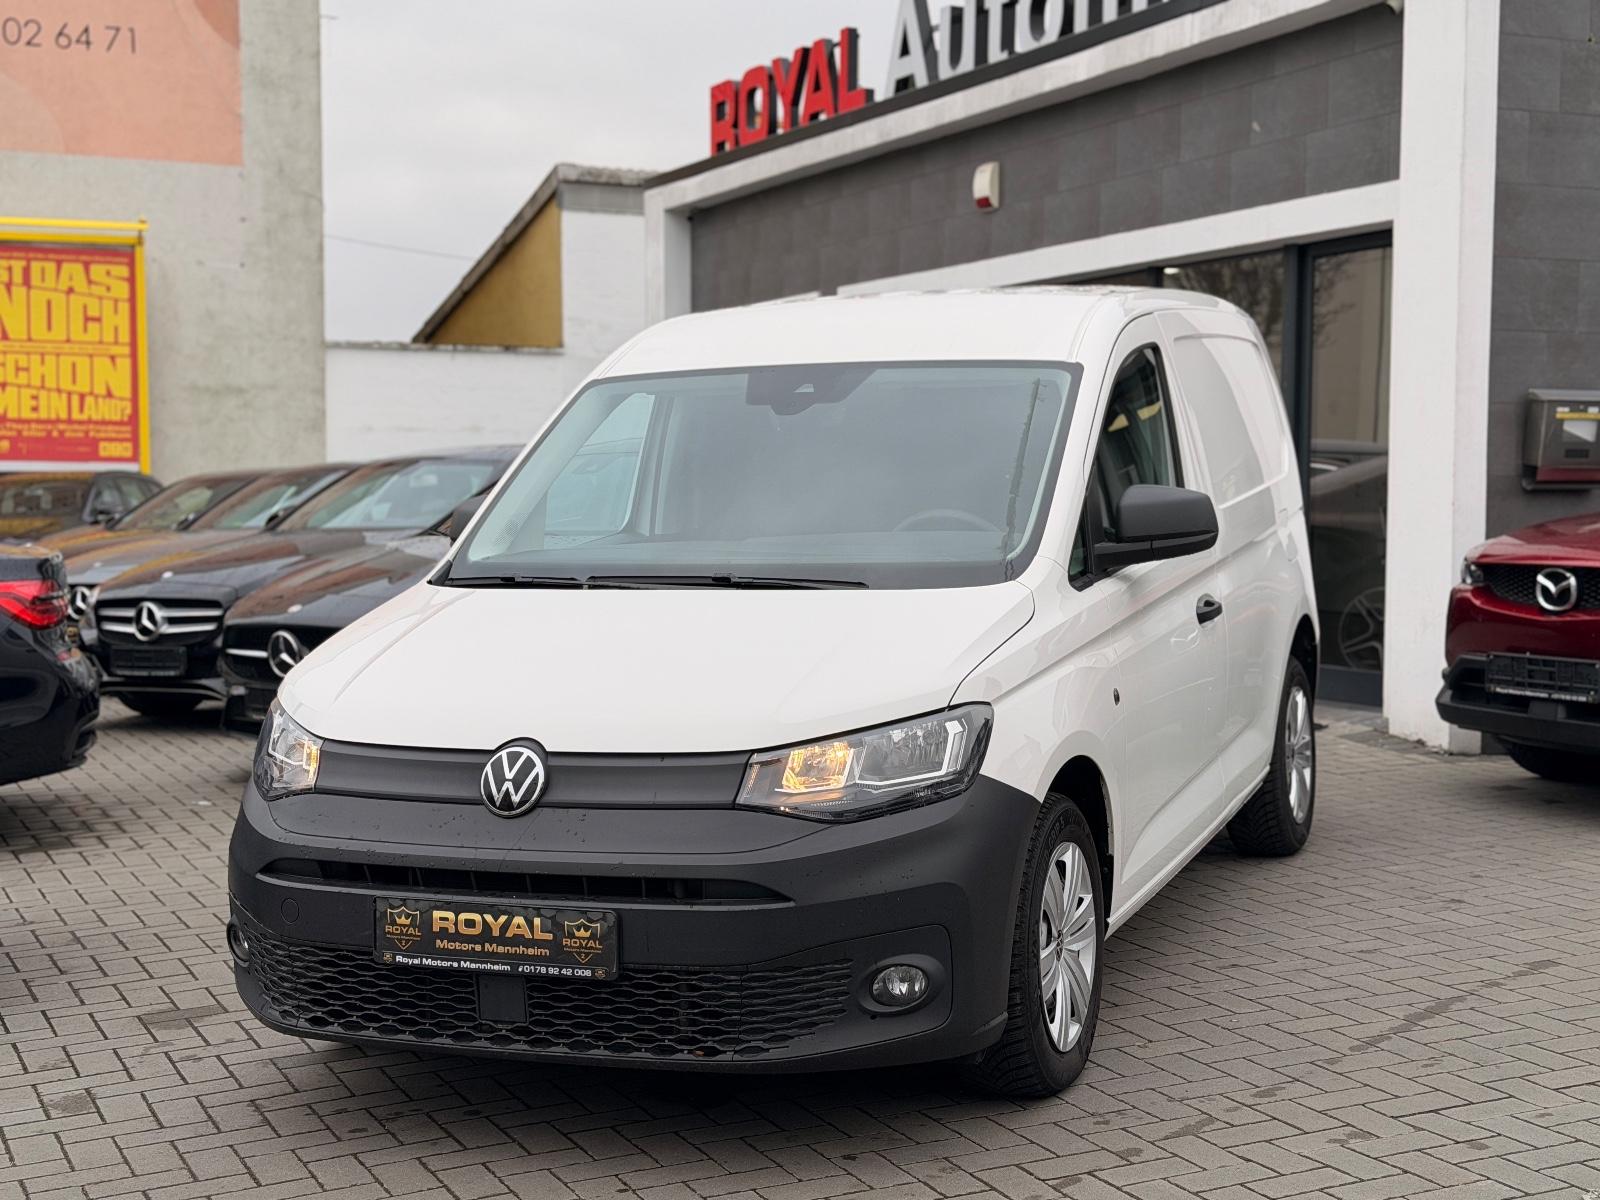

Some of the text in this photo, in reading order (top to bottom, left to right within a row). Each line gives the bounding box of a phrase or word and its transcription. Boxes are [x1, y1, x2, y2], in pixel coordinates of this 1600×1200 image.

[2, 17, 137, 55] 02 64 71
[710, 0, 1170, 157] ROYAL Auto
[30, 260, 130, 300] DAS
[0, 284, 130, 344] NOCH
[0, 351, 131, 399] CHON
[385, 925, 421, 936] ROYAL
[432, 910, 553, 940] ROYAL
[435, 939, 482, 951] Motors
[484, 943, 549, 956] Mannheim
[562, 938, 603, 949] ROYAL
[395, 955, 420, 966] Royal
[422, 957, 458, 967] Motors
[460, 960, 510, 971] Mannheim
[548, 967, 560, 975] 92
[561, 968, 572, 976] 42
